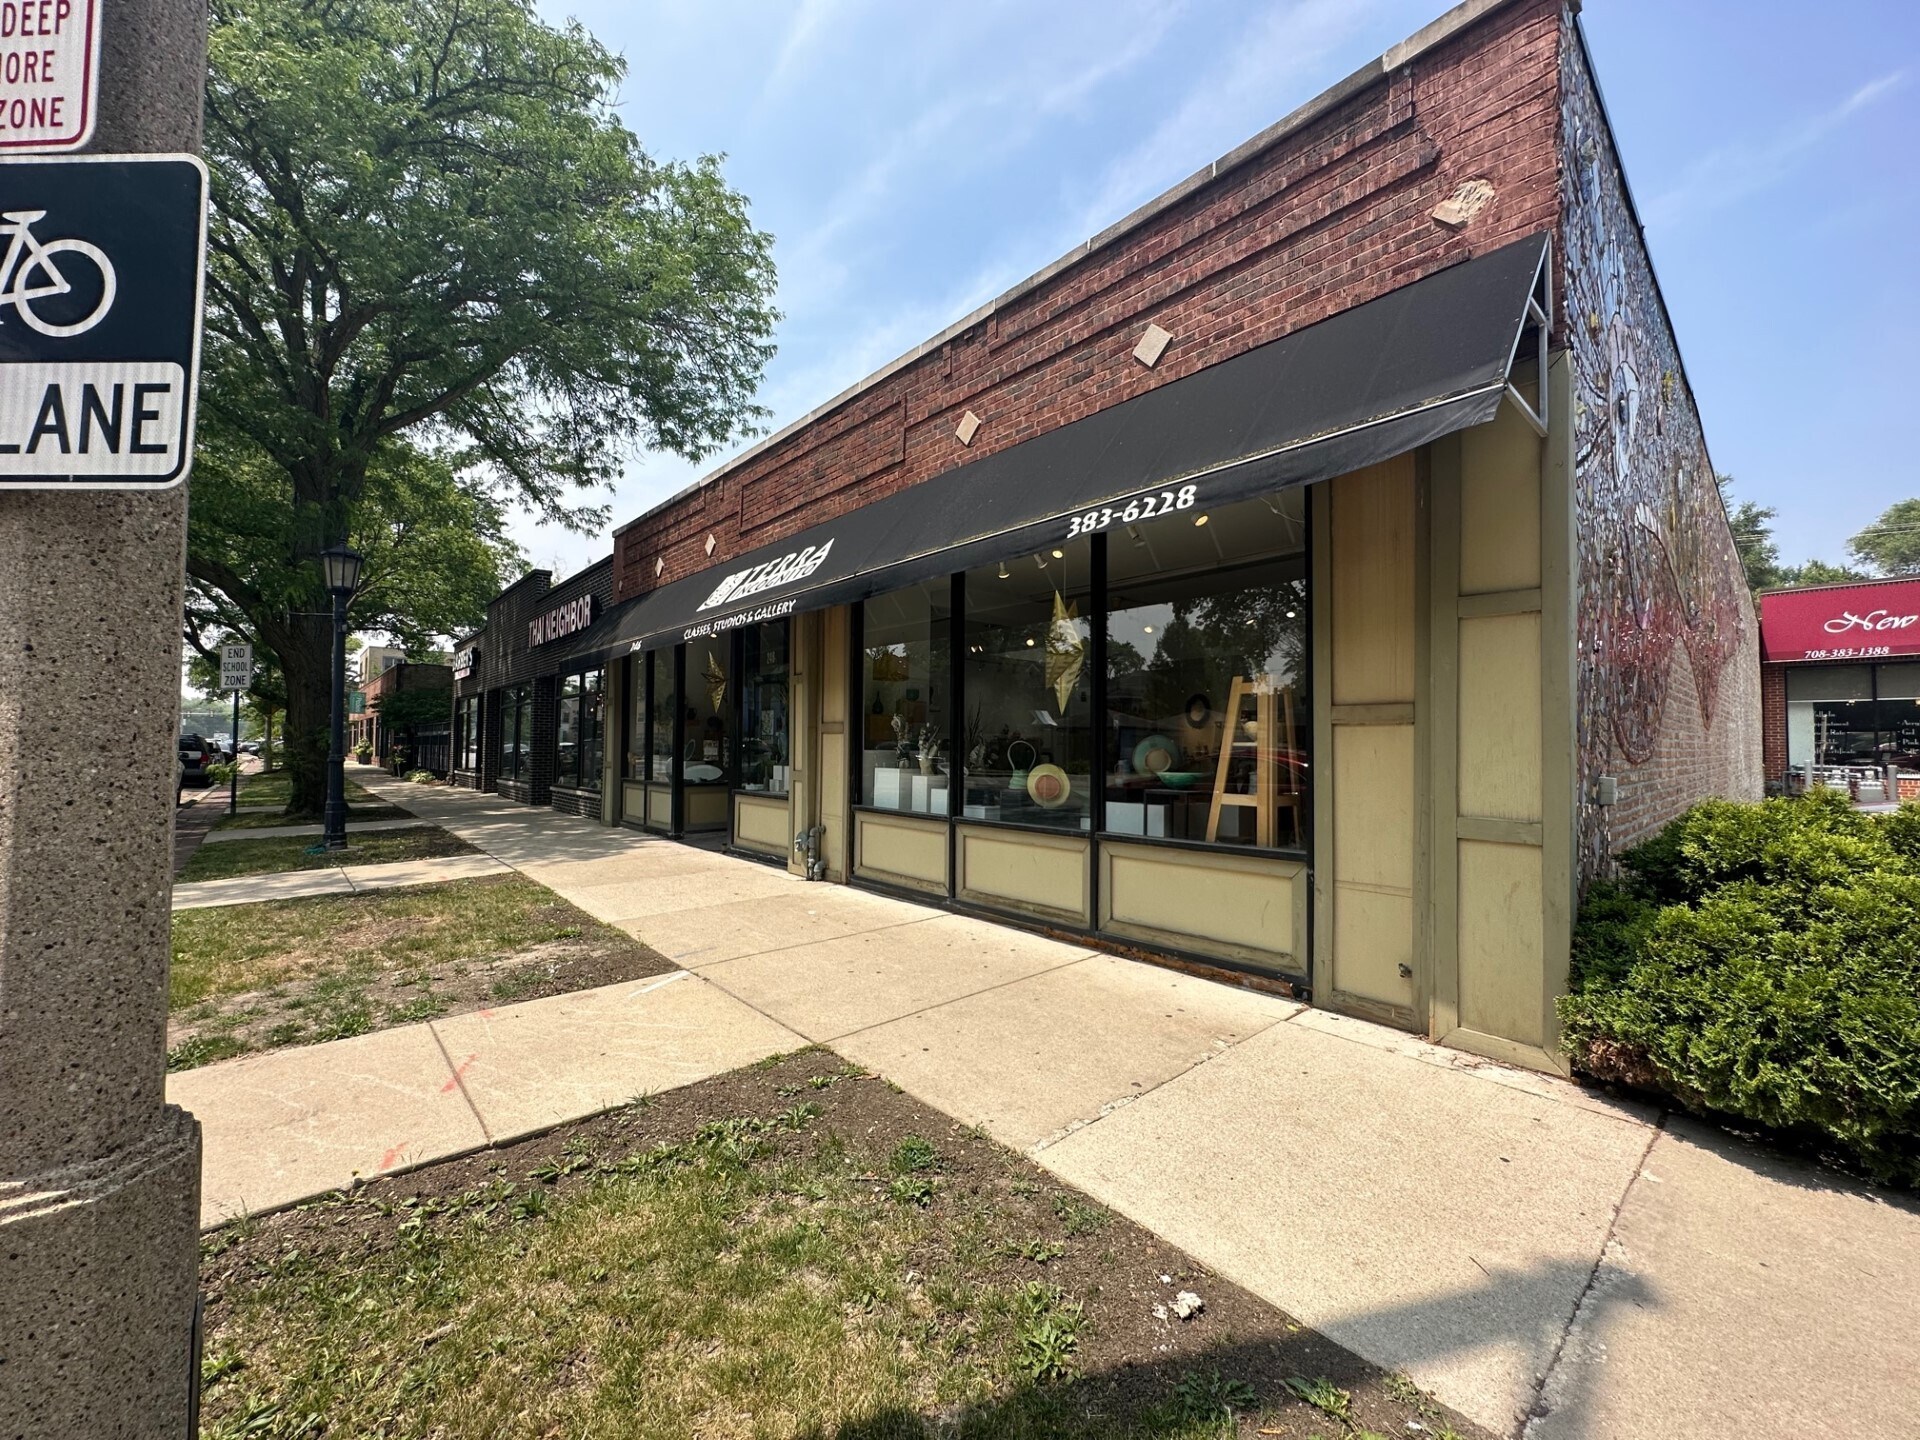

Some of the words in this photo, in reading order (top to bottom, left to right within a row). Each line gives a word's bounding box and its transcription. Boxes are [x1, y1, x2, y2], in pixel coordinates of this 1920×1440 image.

[1, 0, 71, 37] DEEP
[0, 50, 55, 84] ORE
[1066, 484, 1197, 539] 383-6228
[742, 537, 835, 585] TERRA
[528, 617, 544, 648] THAI
[545, 594, 591, 642] NEIGHBOR
[712, 611, 747, 632] STUDIOS
[754, 599, 797, 620] GALLERY
[1823, 609, 1919, 633] New
[223, 662, 248, 672] SCHOOL
[227, 648, 245, 658] END
[1804, 646, 1890, 660] 708-383-1388
[224, 675, 247, 685] ZONE
